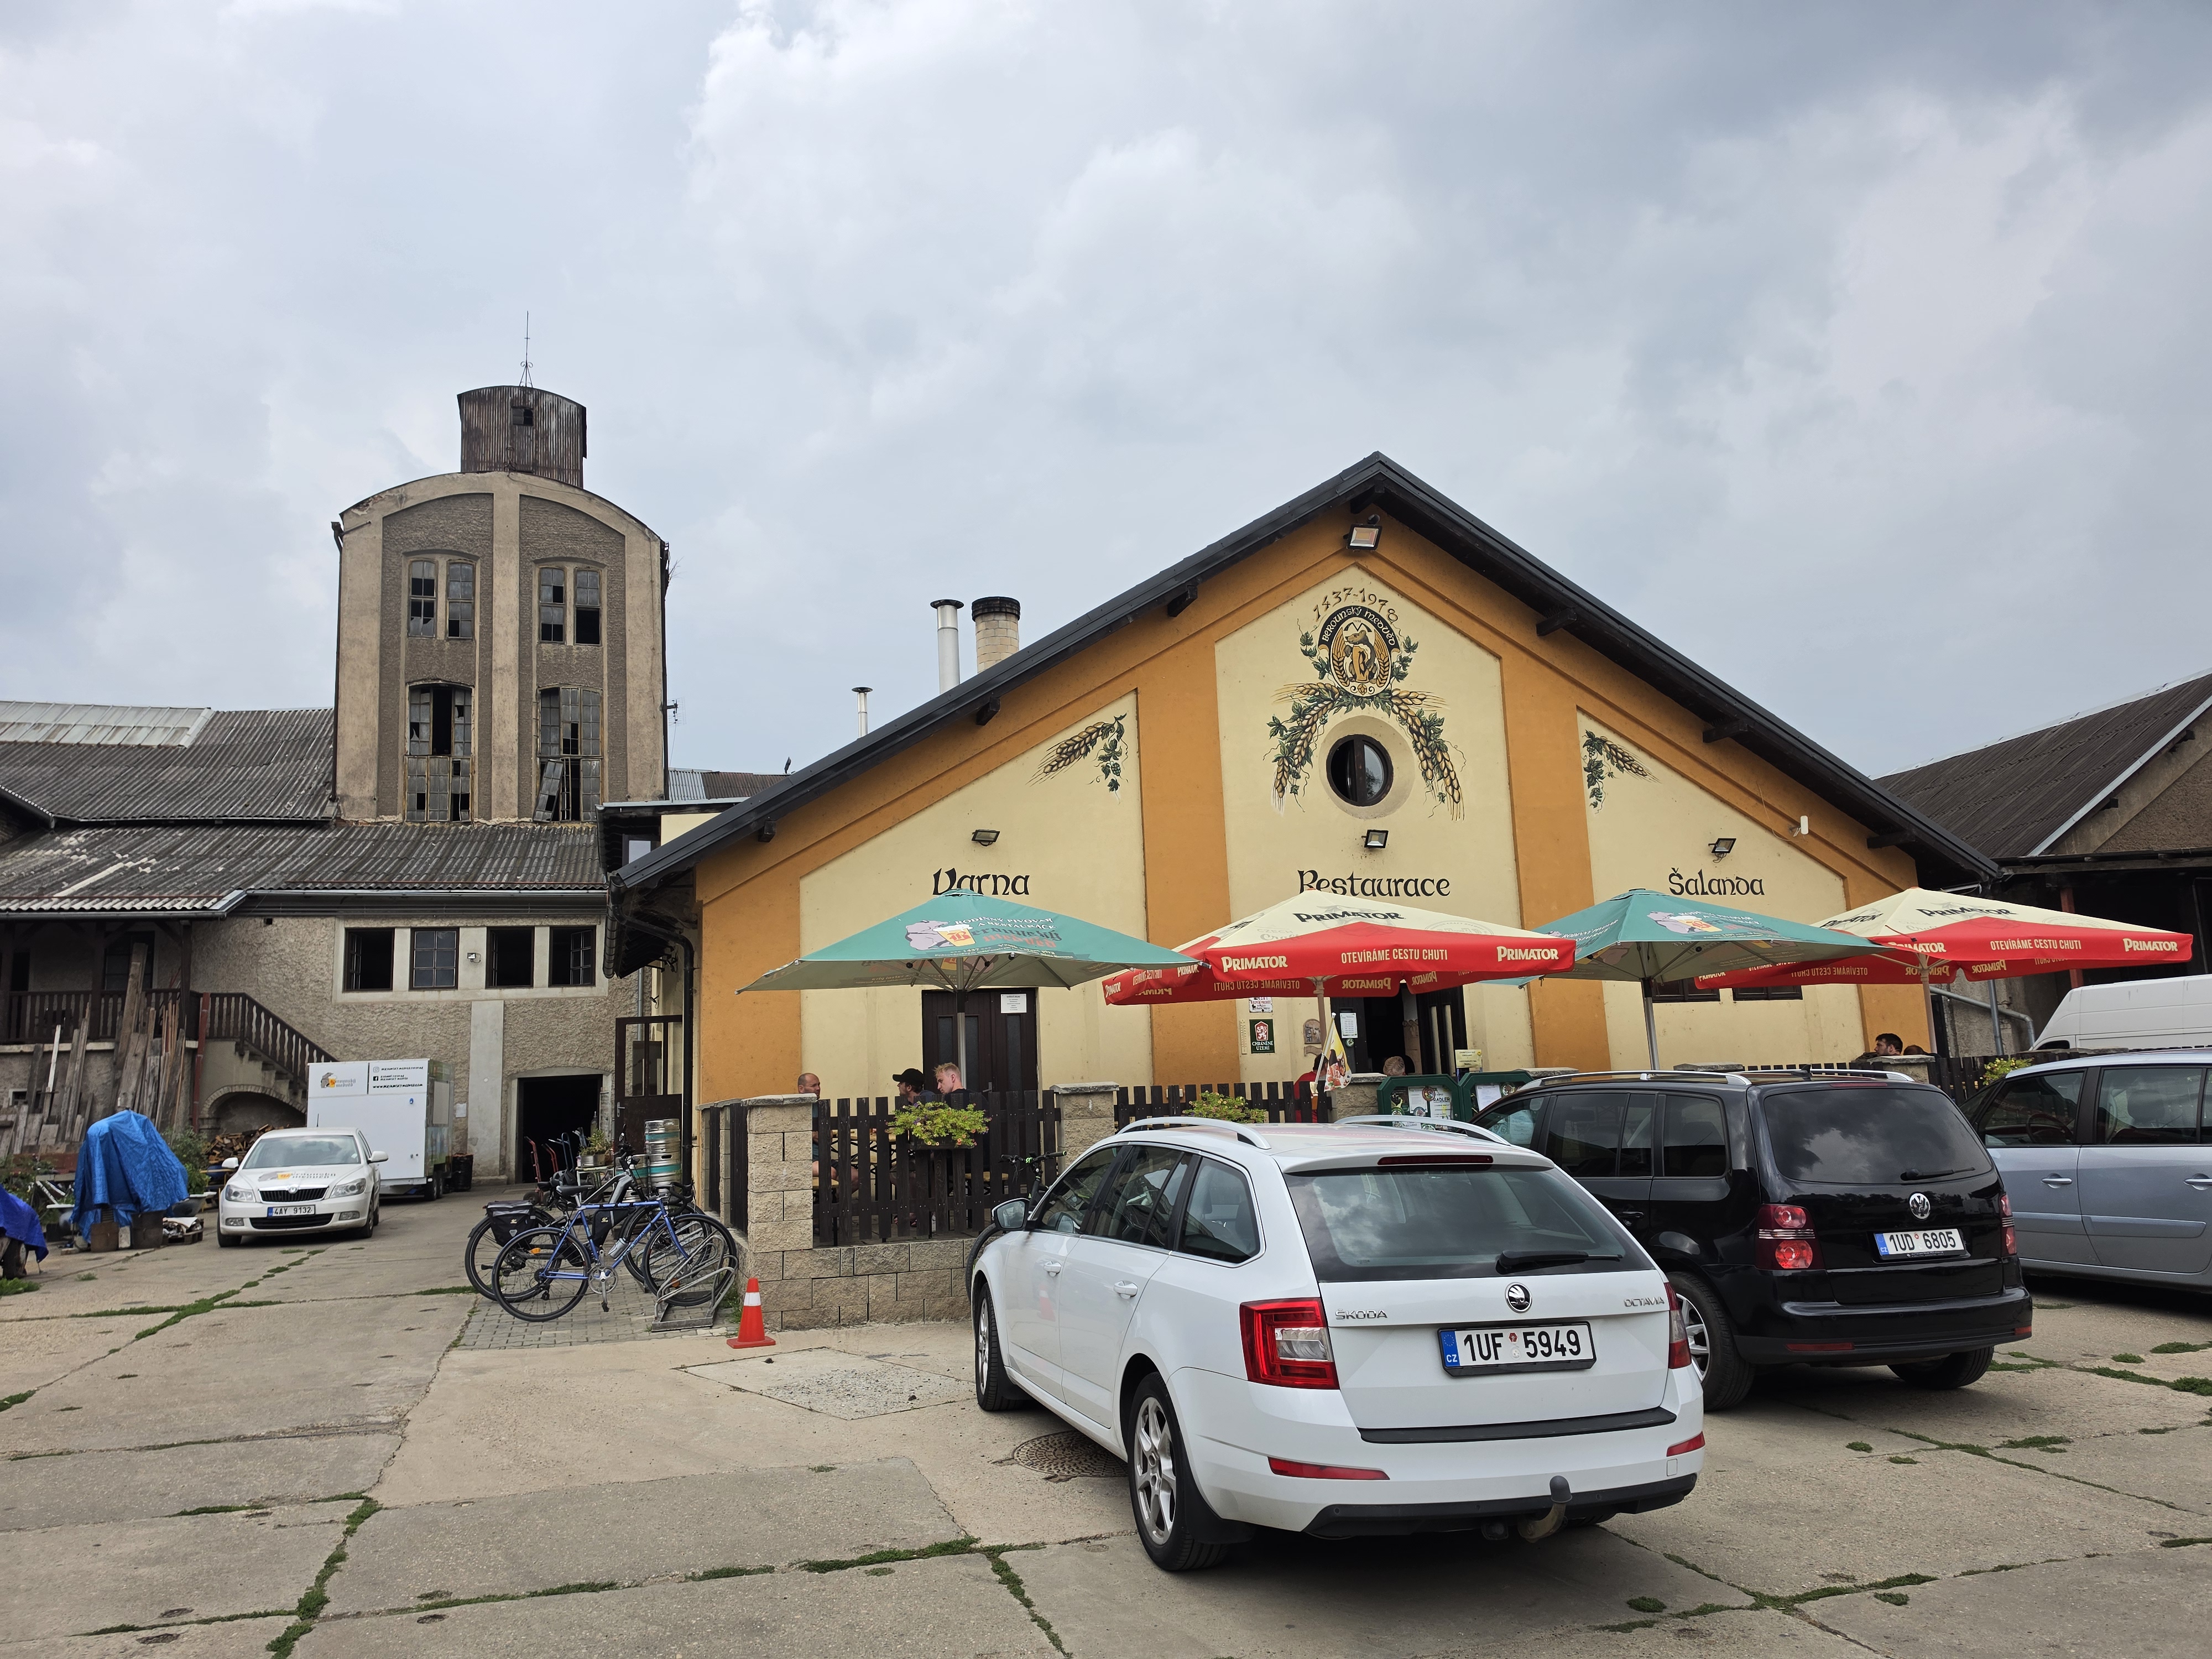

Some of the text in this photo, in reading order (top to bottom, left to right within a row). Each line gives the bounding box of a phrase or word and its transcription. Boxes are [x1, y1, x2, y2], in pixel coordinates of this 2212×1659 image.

[932, 867, 1030, 895] Varna
[1297, 870, 1451, 897] Restaurace
[1668, 867, 1765, 895] Šalanda
[1292, 911, 1405, 922] PRIMATOR
[1916, 907, 2017, 917] PRIMATOR
[955, 916, 1004, 925] RODINNÝ
[1990, 938, 2081, 951] OTEVÍRÁME CESTU CHUTI
[2122, 938, 2178, 952] PRIMATOR
[1341, 948, 1448, 964] OTEVÍRÁME CESTU CHUTI
[1496, 946, 1559, 962] PRIMATOR
[1221, 956, 1288, 973] PRIMATOR
[1890, 1231, 1956, 1251] 1UD 6805
[1624, 1296, 1665, 1307] OCTAVIA
[1335, 1308, 1387, 1319] ŠKODA
[1464, 1329, 1581, 1361] 1UF 5949
[1446, 1354, 1458, 1363] CZ
